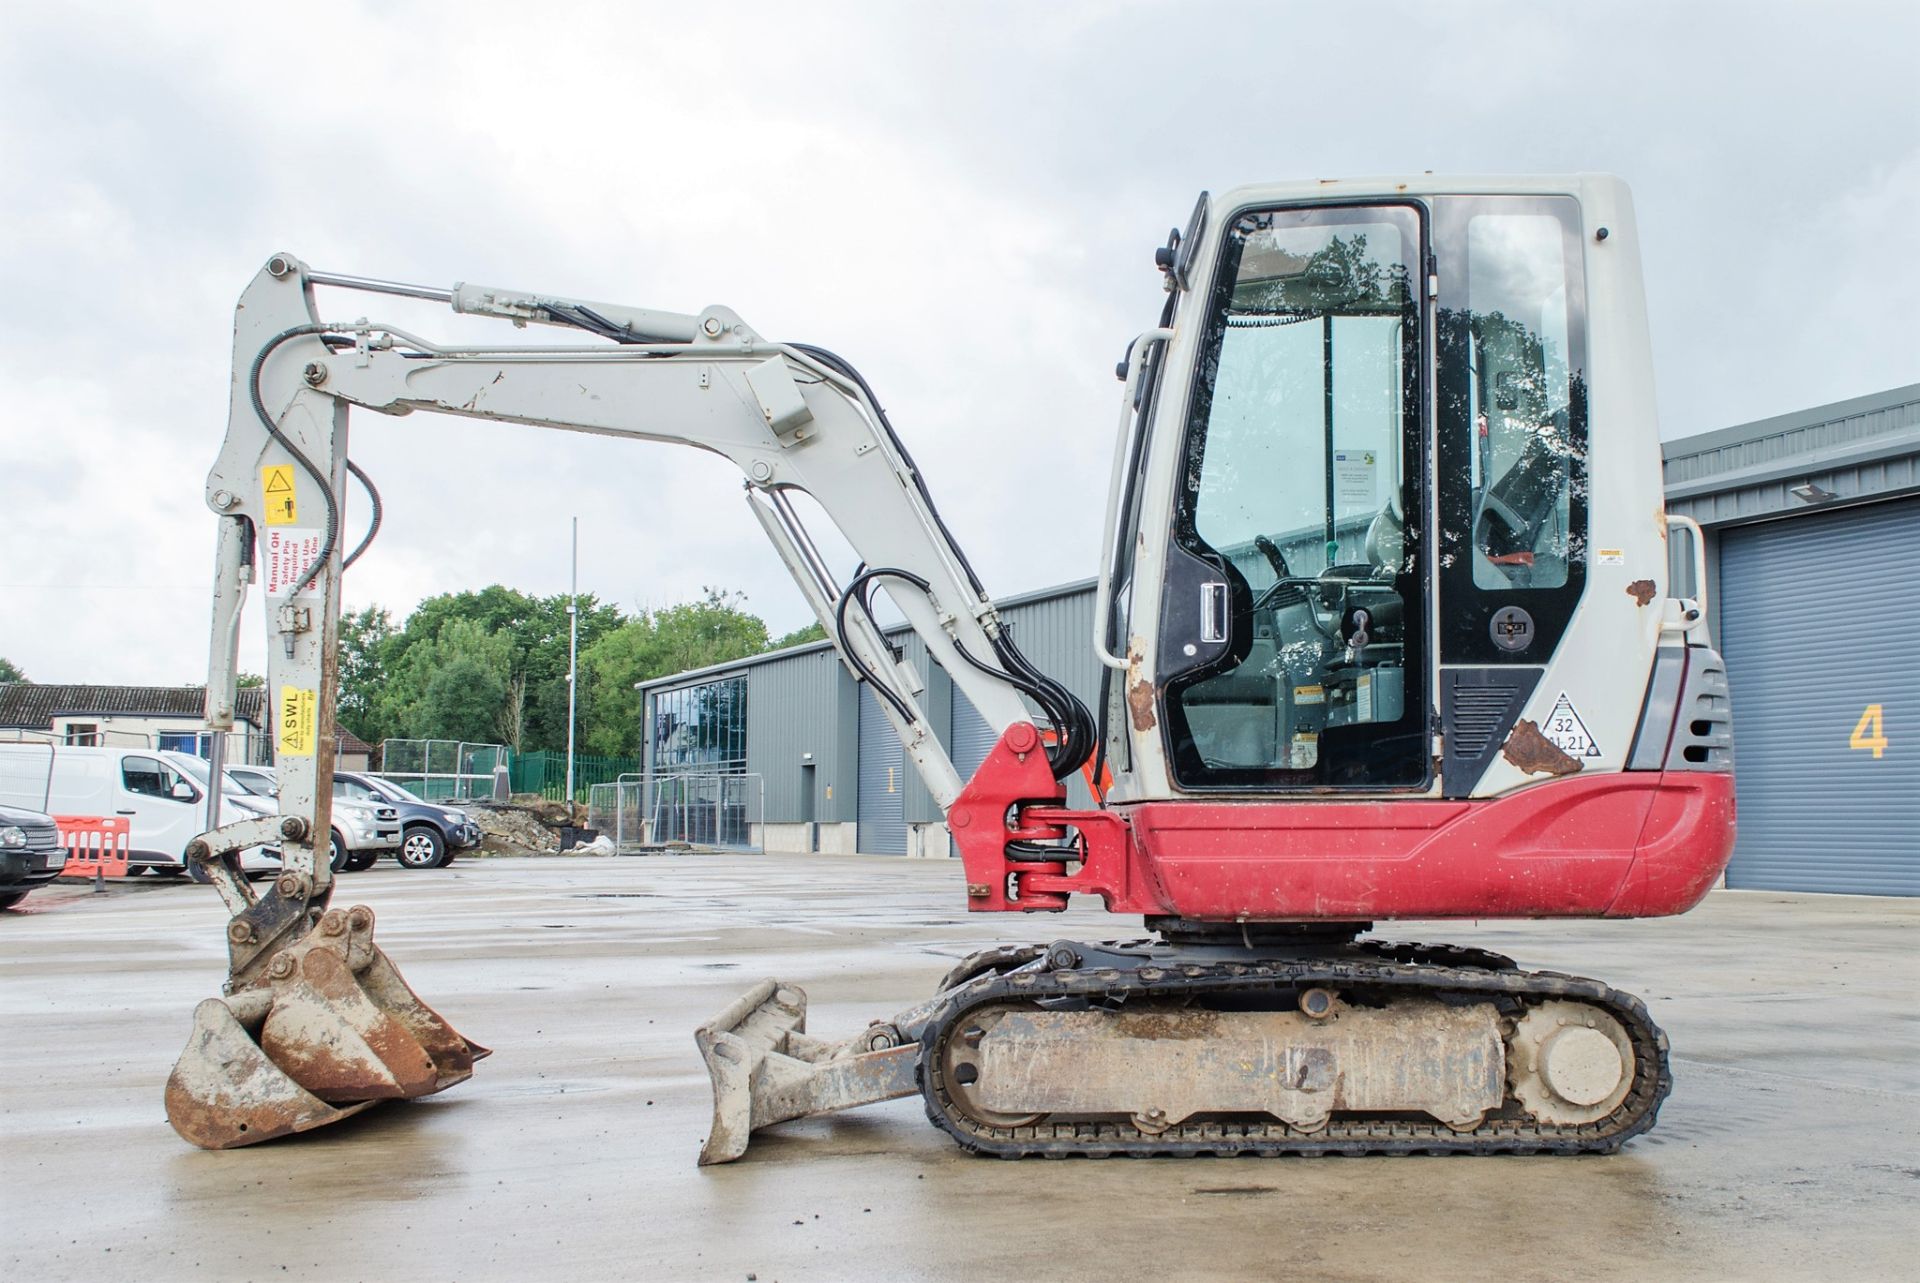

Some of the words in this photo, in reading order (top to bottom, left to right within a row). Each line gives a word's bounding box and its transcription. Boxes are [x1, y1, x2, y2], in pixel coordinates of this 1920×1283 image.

[271, 532, 280, 548] QH
[269, 552, 279, 593] Manual
[282, 557, 290, 585] Safety
[291, 544, 299, 582] Required
[285, 693, 298, 729] SWL
[1555, 718, 1573, 732] 32
[1850, 703, 1888, 759] 4
